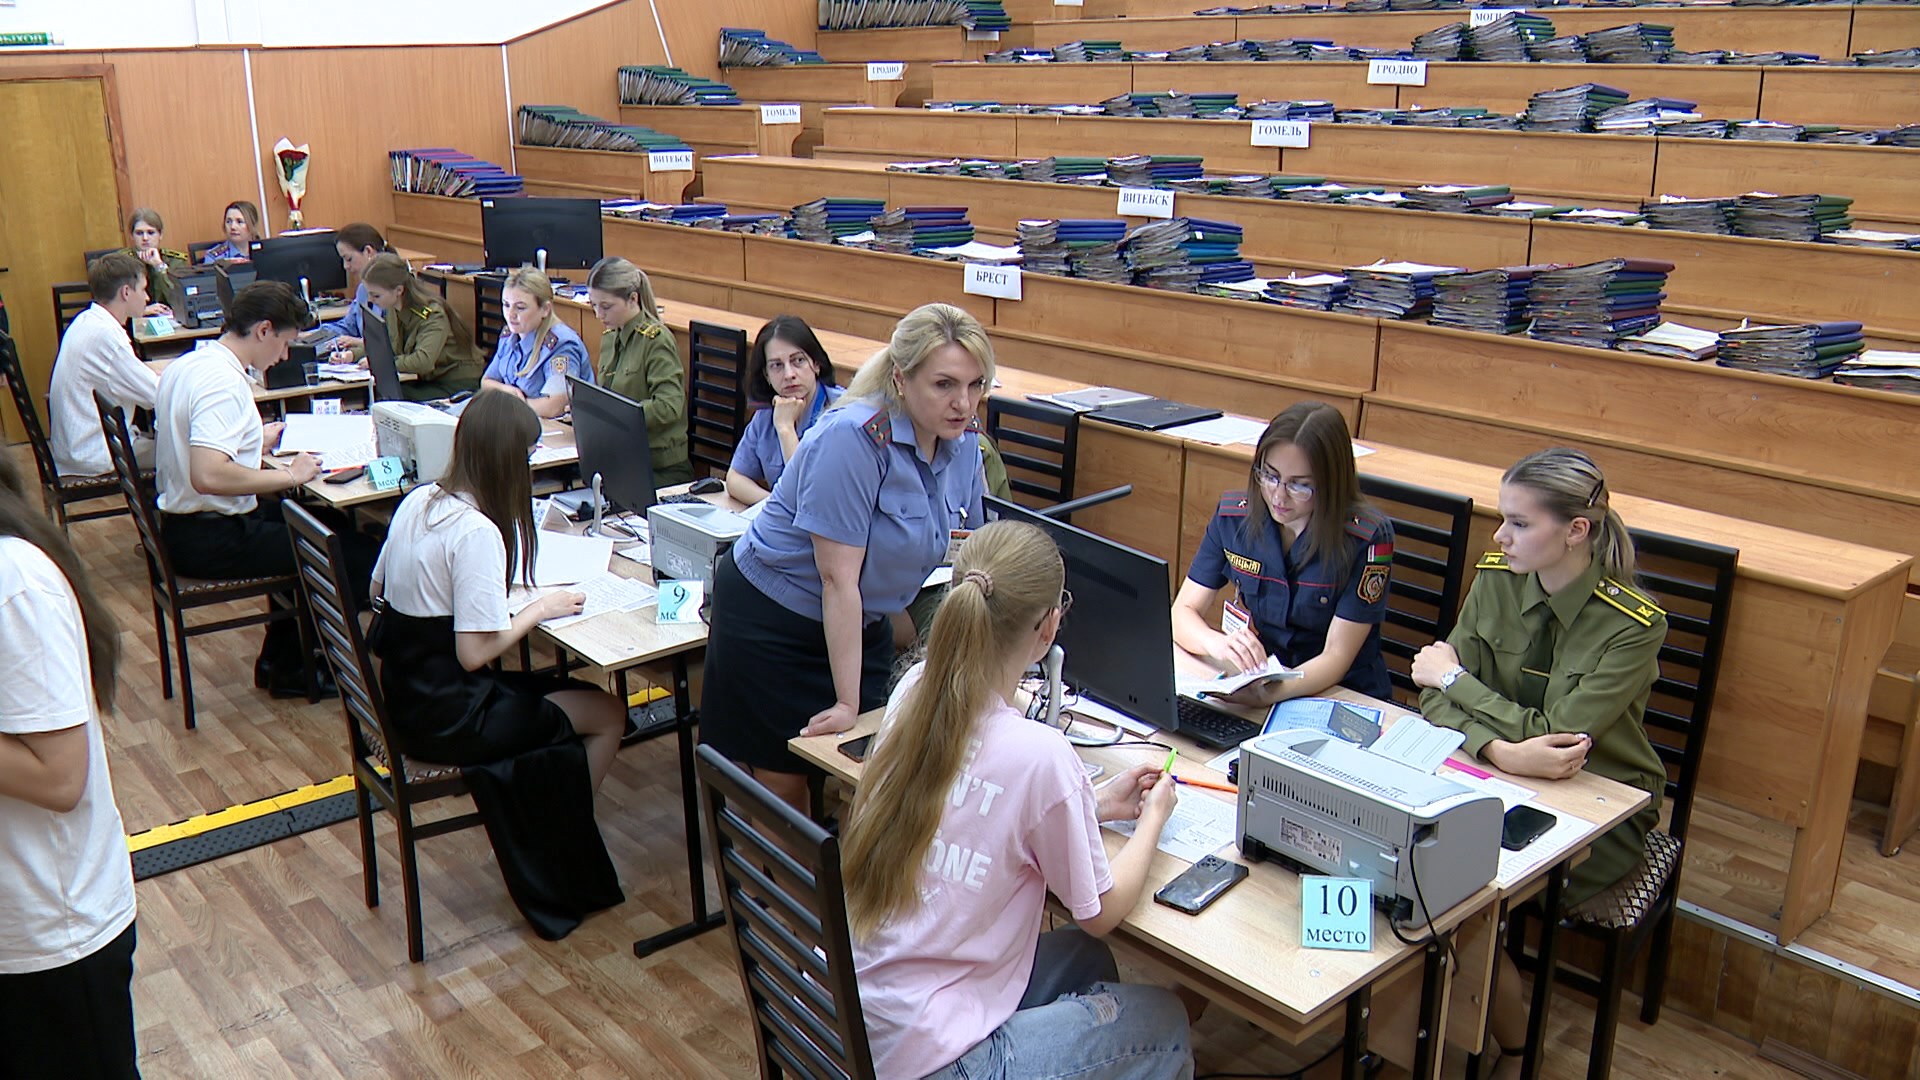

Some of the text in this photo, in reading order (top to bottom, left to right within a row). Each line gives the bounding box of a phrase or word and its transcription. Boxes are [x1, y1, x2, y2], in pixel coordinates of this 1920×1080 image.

[1475, 12, 1502, 21] МОГИ
[1376, 64, 1418, 75] ГРОДНО
[765, 108, 797, 117] ГОМЕЛЬ
[1258, 125, 1302, 136] ГОМЕЛЬ
[1122, 193, 1169, 206] ВИТЕБСК
[976, 270, 1009, 285] БРЕСТ
[381, 460, 392, 474] 8
[673, 584, 685, 604] 9
[1320, 884, 1358, 917] 10
[1306, 928, 1367, 944] место
